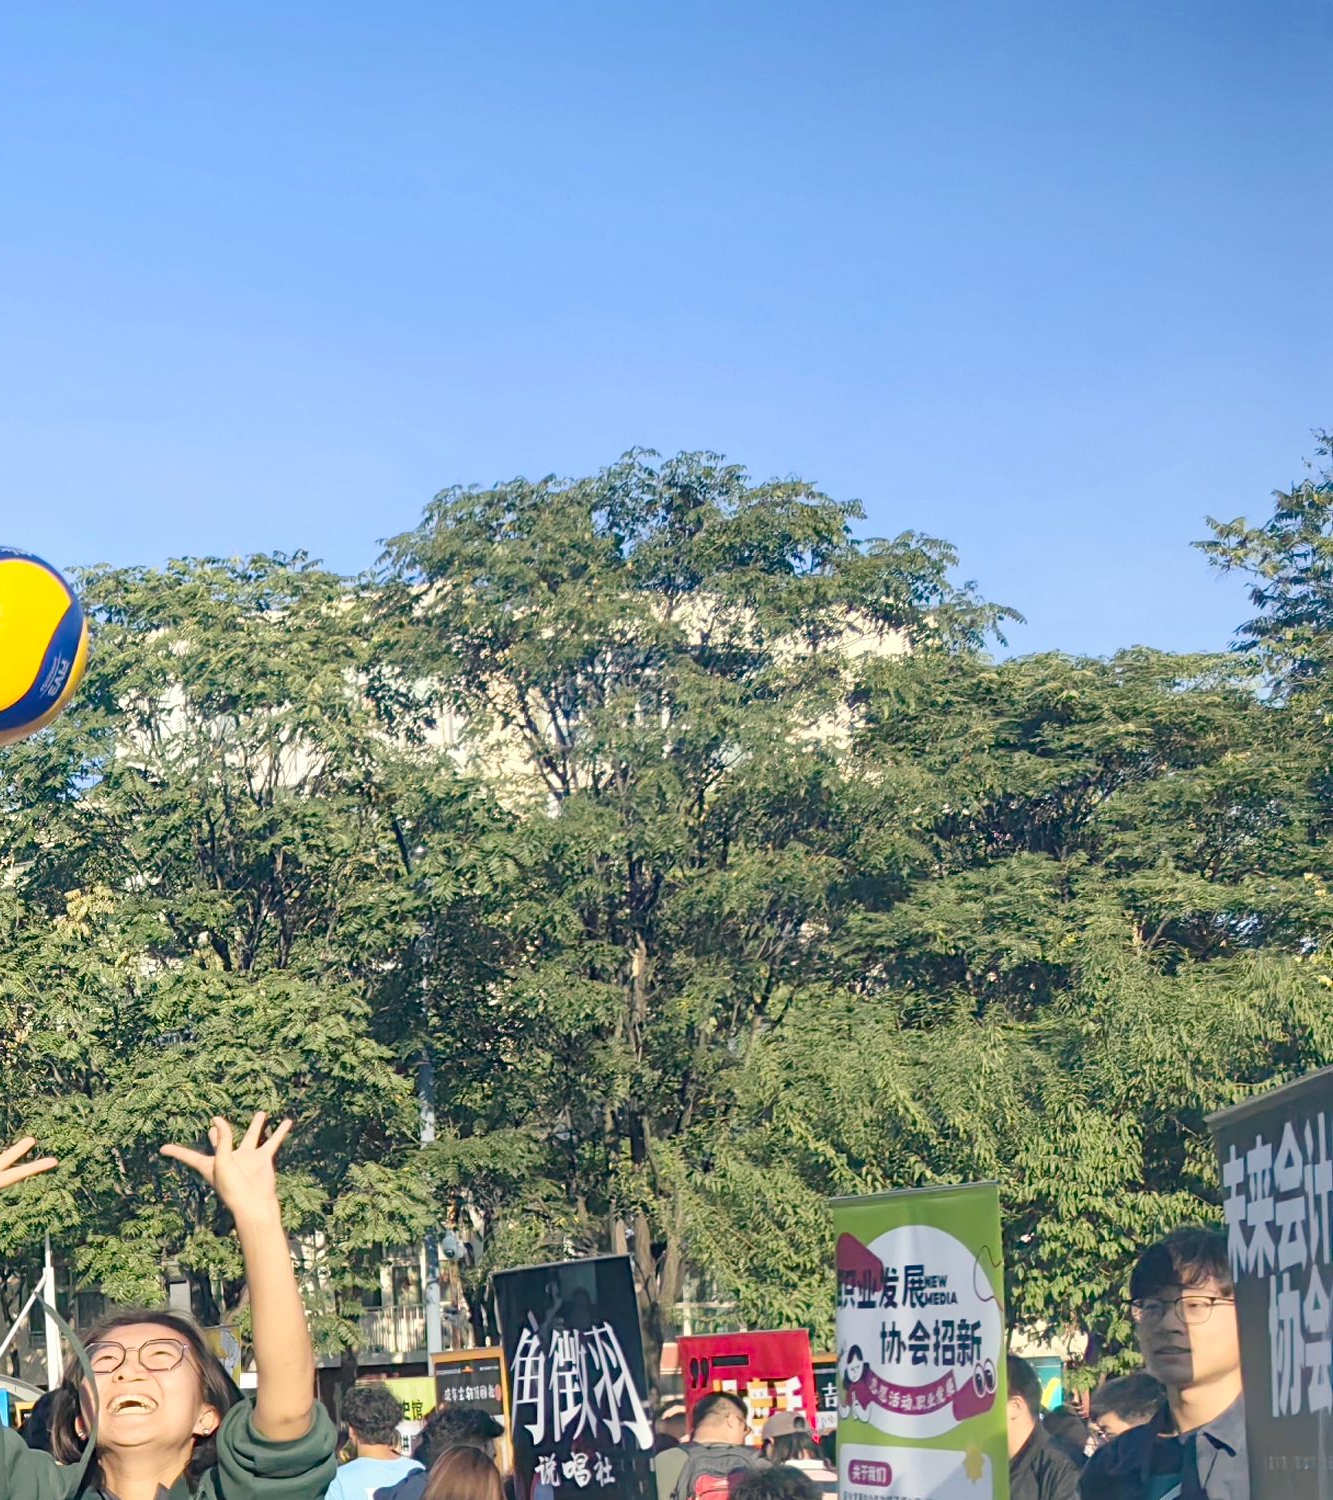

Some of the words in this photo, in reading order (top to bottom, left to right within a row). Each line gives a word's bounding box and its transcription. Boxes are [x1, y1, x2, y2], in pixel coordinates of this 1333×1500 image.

[880, 1319, 982, 1366] 协会招新
[535, 1452, 616, 1488] 说唱社
